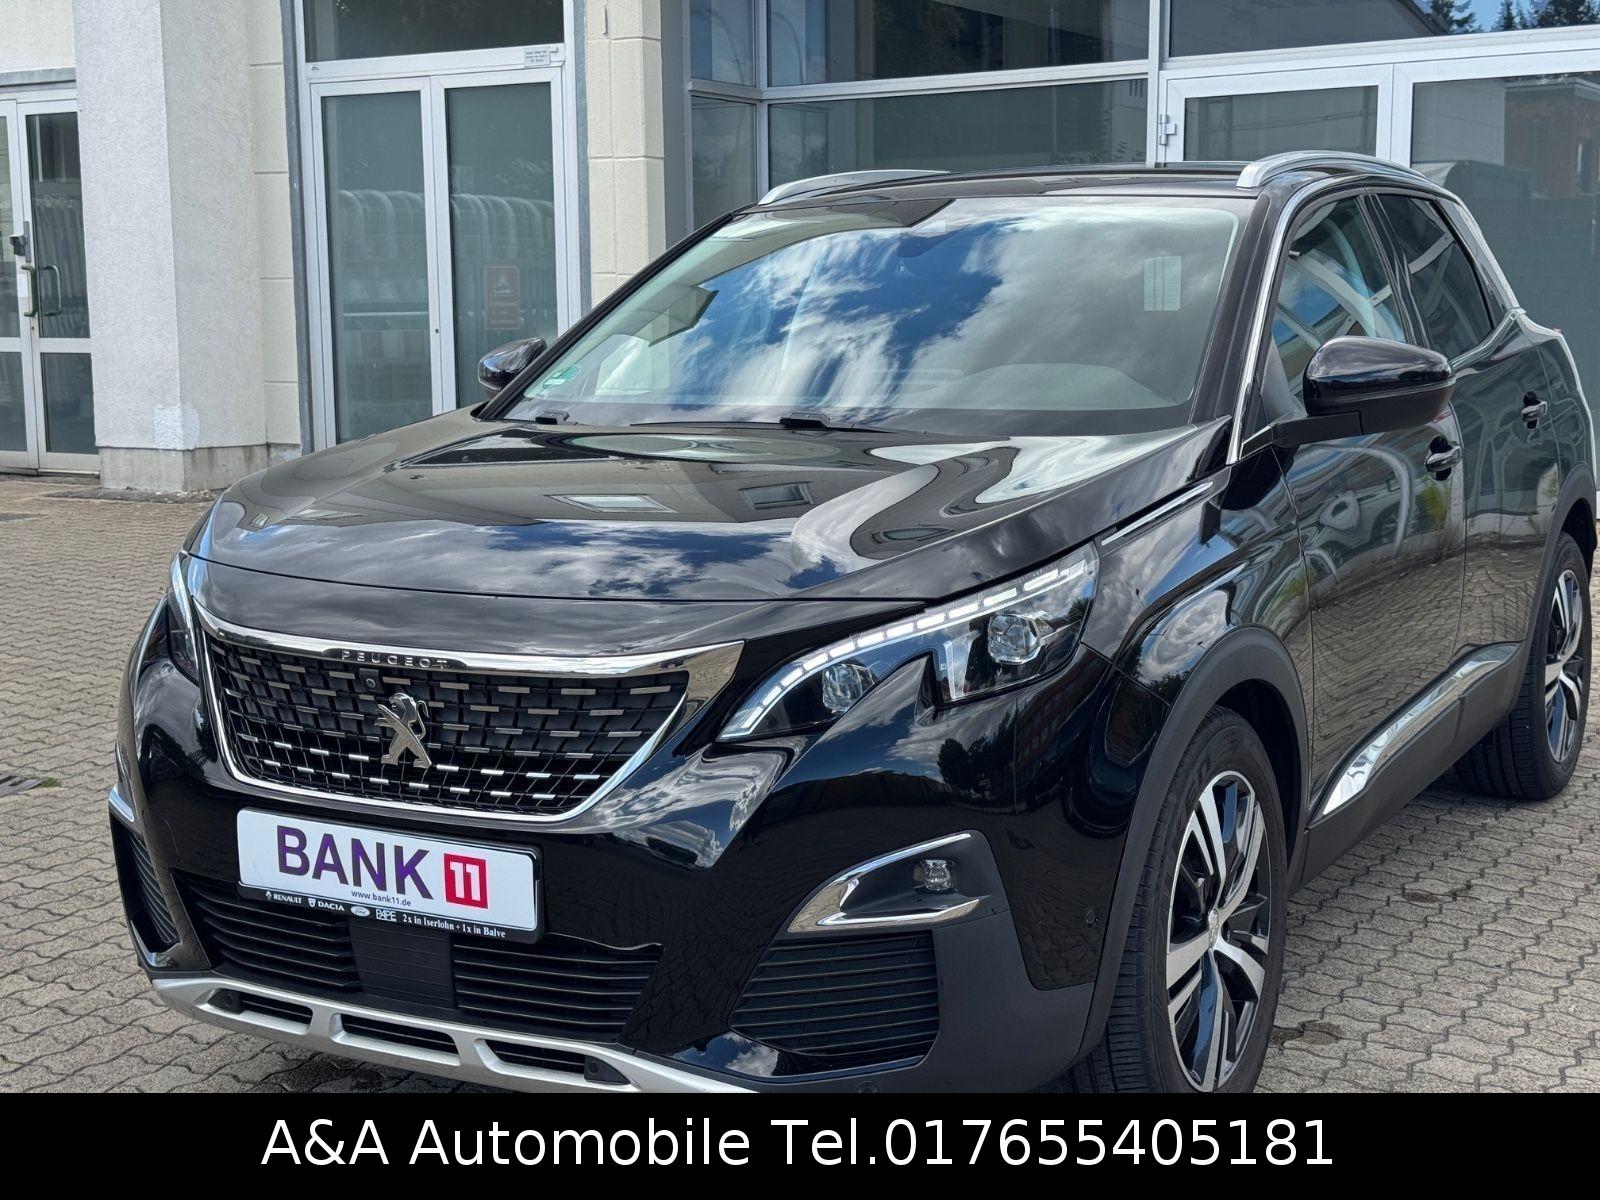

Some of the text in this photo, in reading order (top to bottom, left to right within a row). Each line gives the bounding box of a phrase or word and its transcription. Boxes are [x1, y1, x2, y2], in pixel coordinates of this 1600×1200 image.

[341, 650, 448, 669] PEUGEOT
[276, 824, 434, 900] BANK
[351, 889, 412, 908] www.bank11.de
[273, 893, 303, 904] RENAULT
[318, 900, 345, 912] DACIA
[402, 914, 412, 924] 2x
[414, 915, 422, 925] in
[424, 917, 455, 931] Iserlohn
[462, 923, 472, 934] 1x
[473, 925, 482, 935] in
[483, 926, 506, 938] Balve
